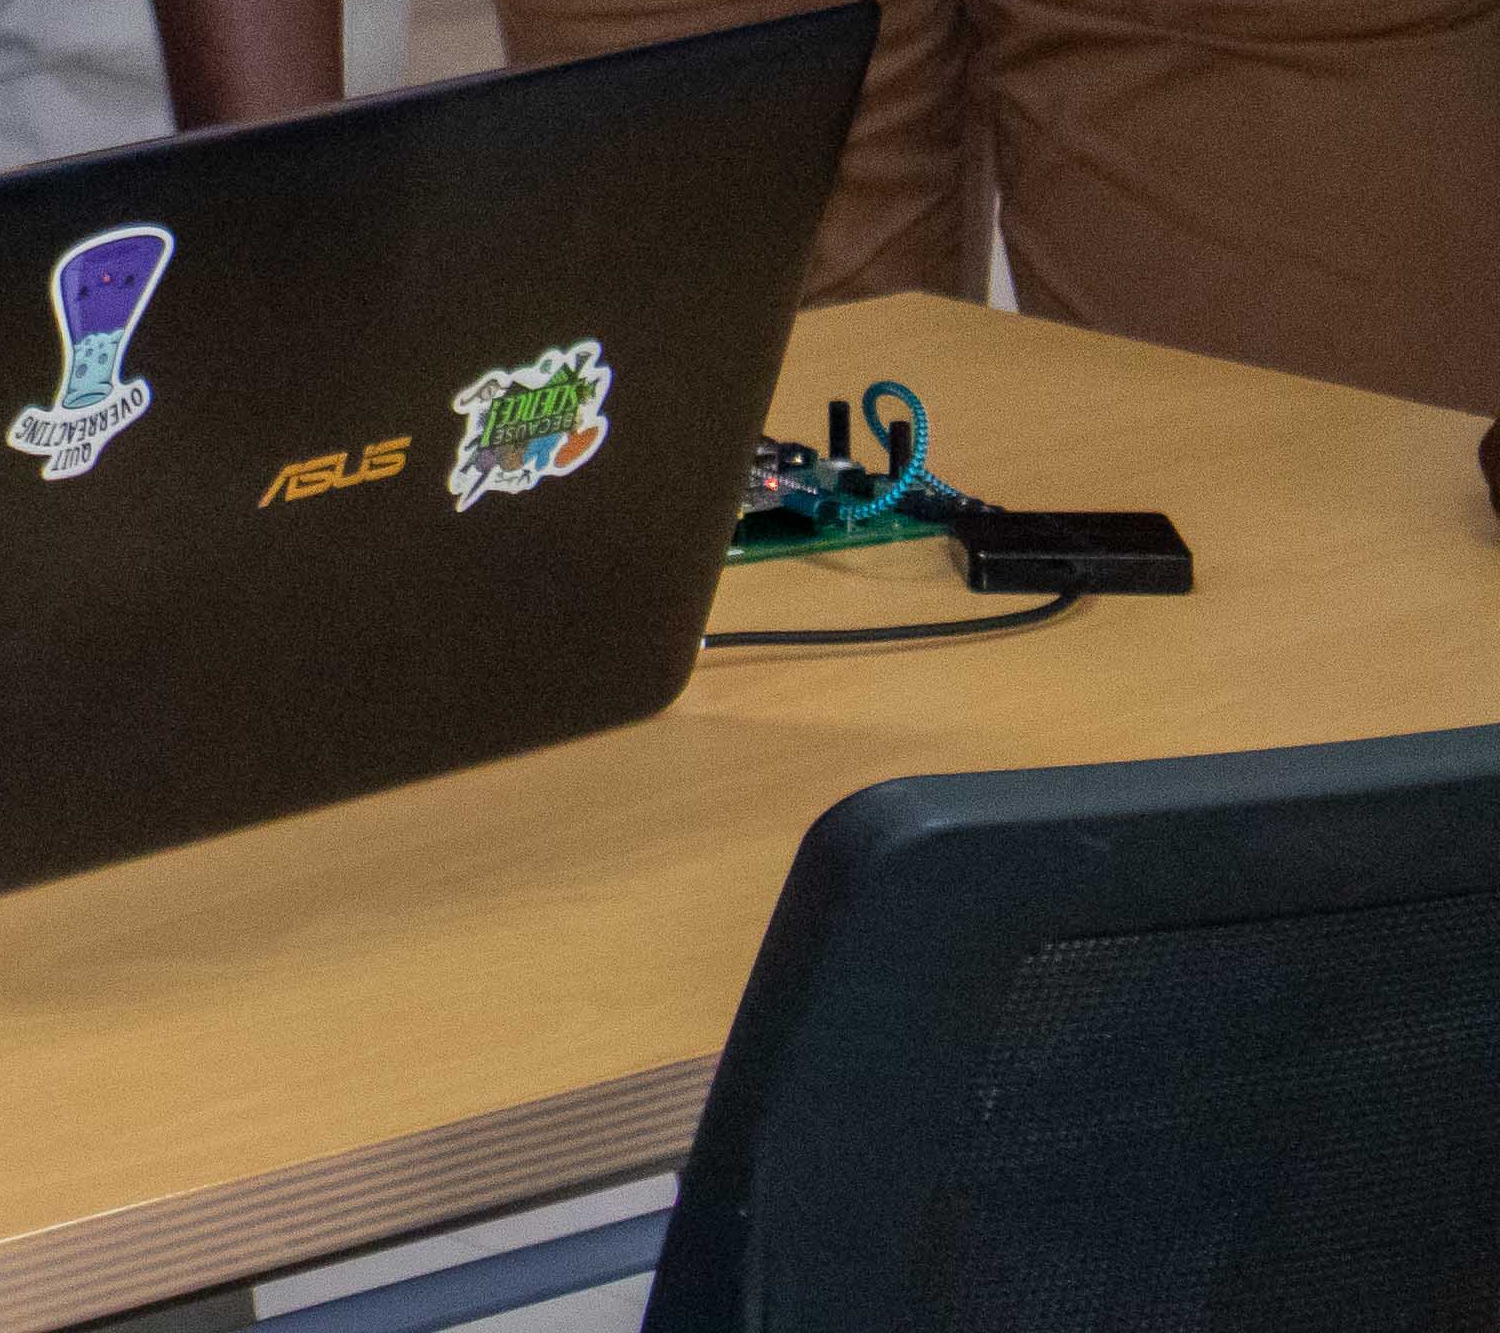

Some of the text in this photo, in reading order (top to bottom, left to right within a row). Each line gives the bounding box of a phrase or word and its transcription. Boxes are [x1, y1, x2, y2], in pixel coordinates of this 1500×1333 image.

[15, 387, 143, 447] OVERREACTING
[493, 411, 575, 445] BECAUSE
[51, 442, 93, 471] QUIT
[257, 436, 413, 509] ASUS
